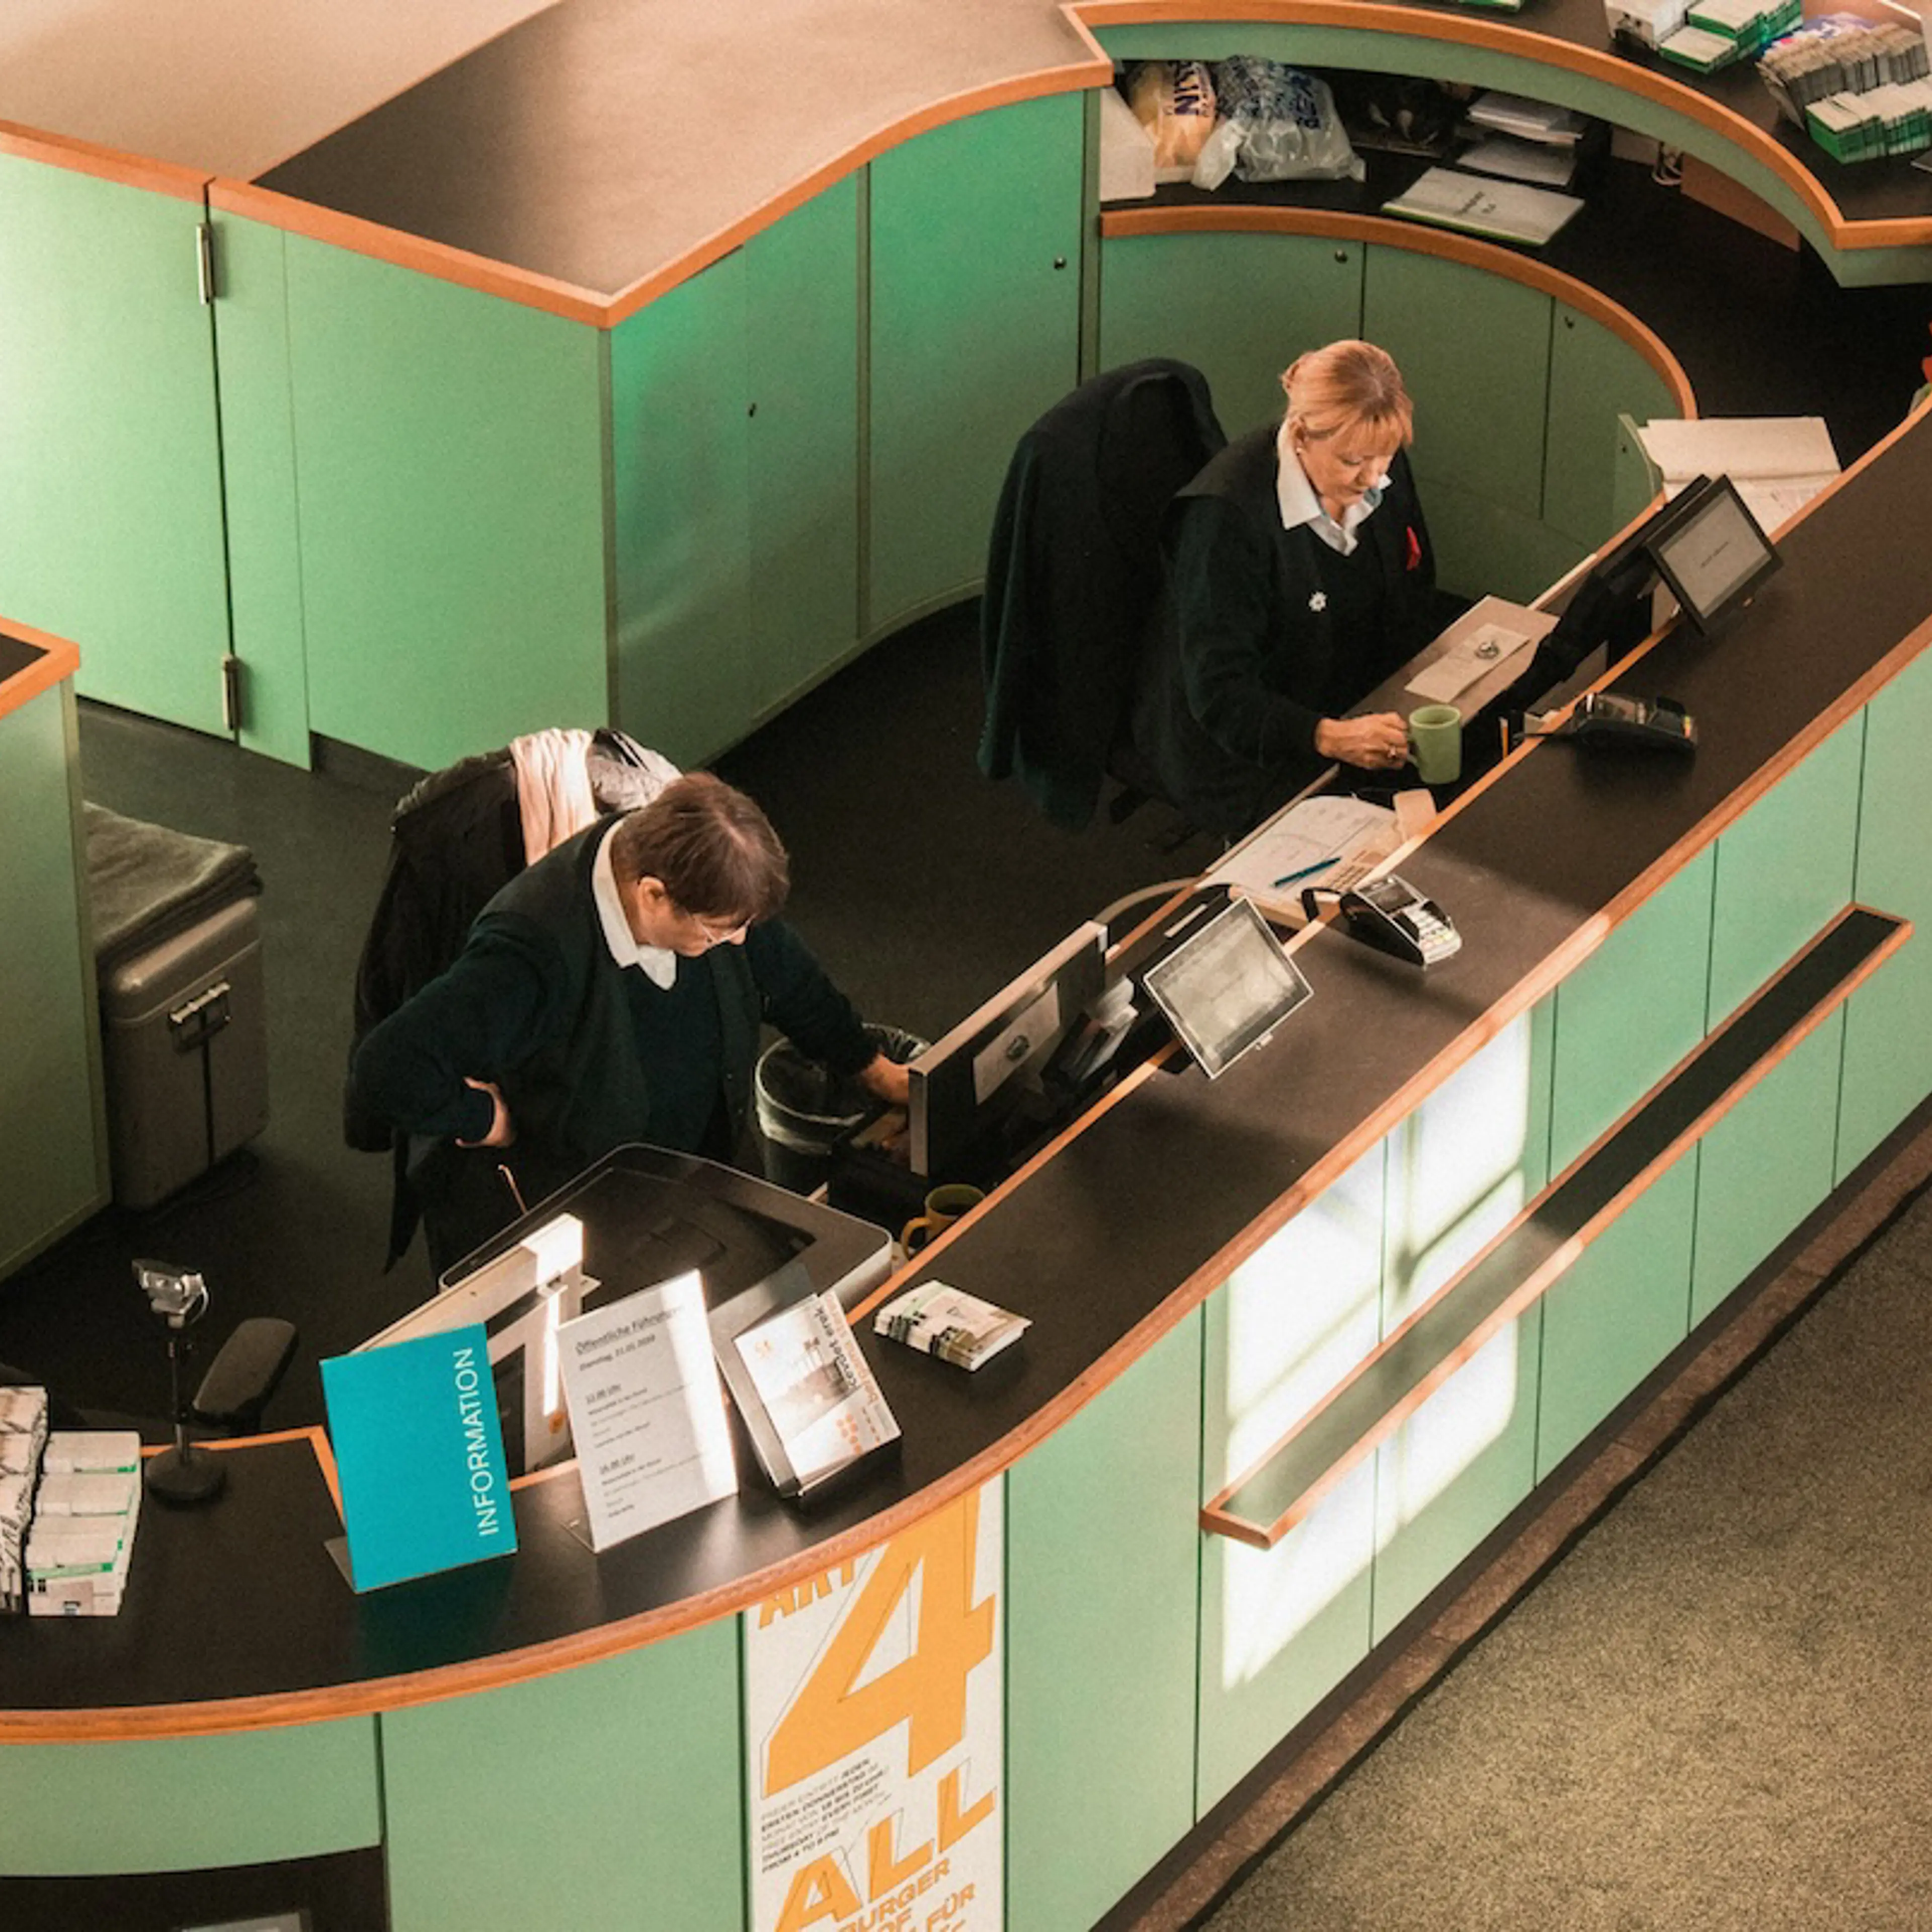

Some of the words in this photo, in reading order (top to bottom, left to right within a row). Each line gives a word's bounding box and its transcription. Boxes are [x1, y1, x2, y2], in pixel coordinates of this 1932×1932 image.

[452, 1347, 499, 1537] INFORMATION
[765, 1484, 995, 1799] 4
[774, 1767, 997, 1932] ALL
